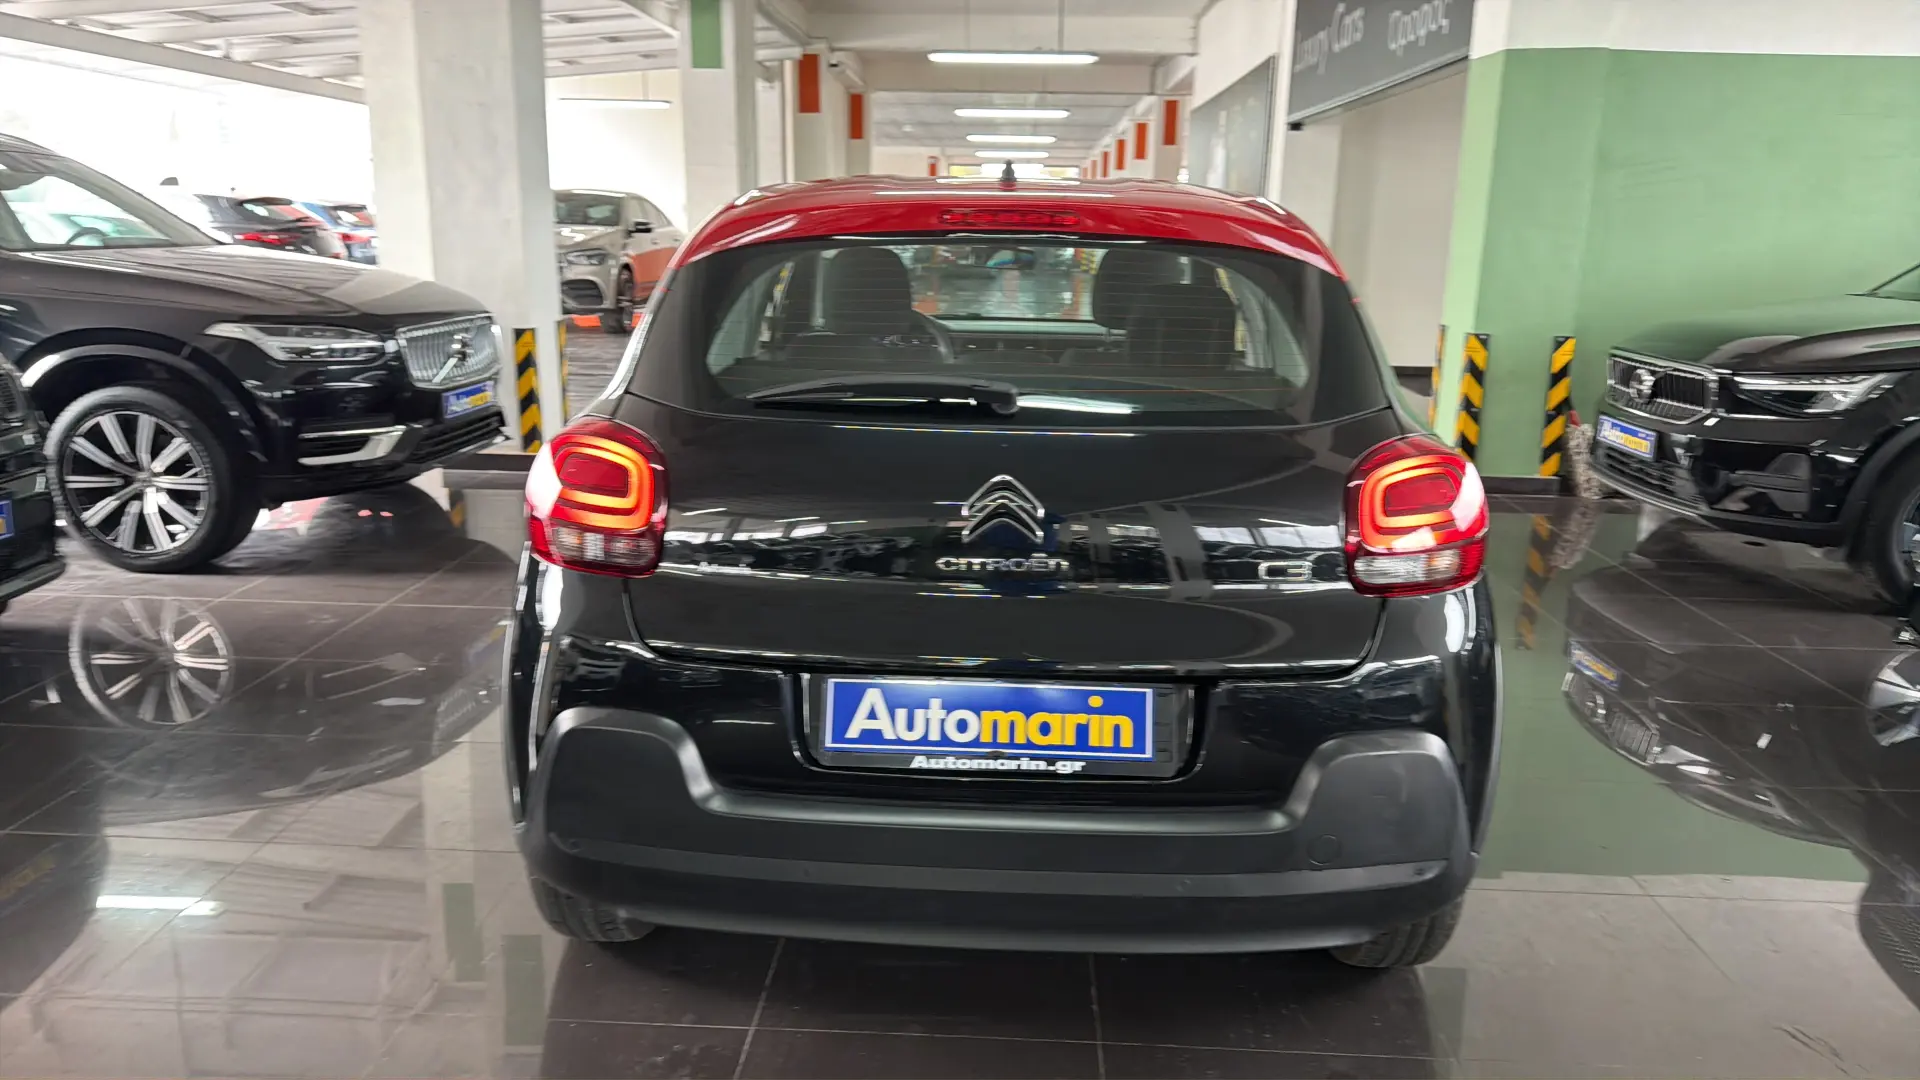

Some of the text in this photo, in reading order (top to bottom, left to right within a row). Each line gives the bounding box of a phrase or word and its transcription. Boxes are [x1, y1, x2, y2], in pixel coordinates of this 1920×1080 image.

[1331, 3, 1365, 52] Cars
[1258, 560, 1312, 581] C3
[845, 687, 1134, 748] Automarin
[910, 755, 1087, 773] Automarin.gr
